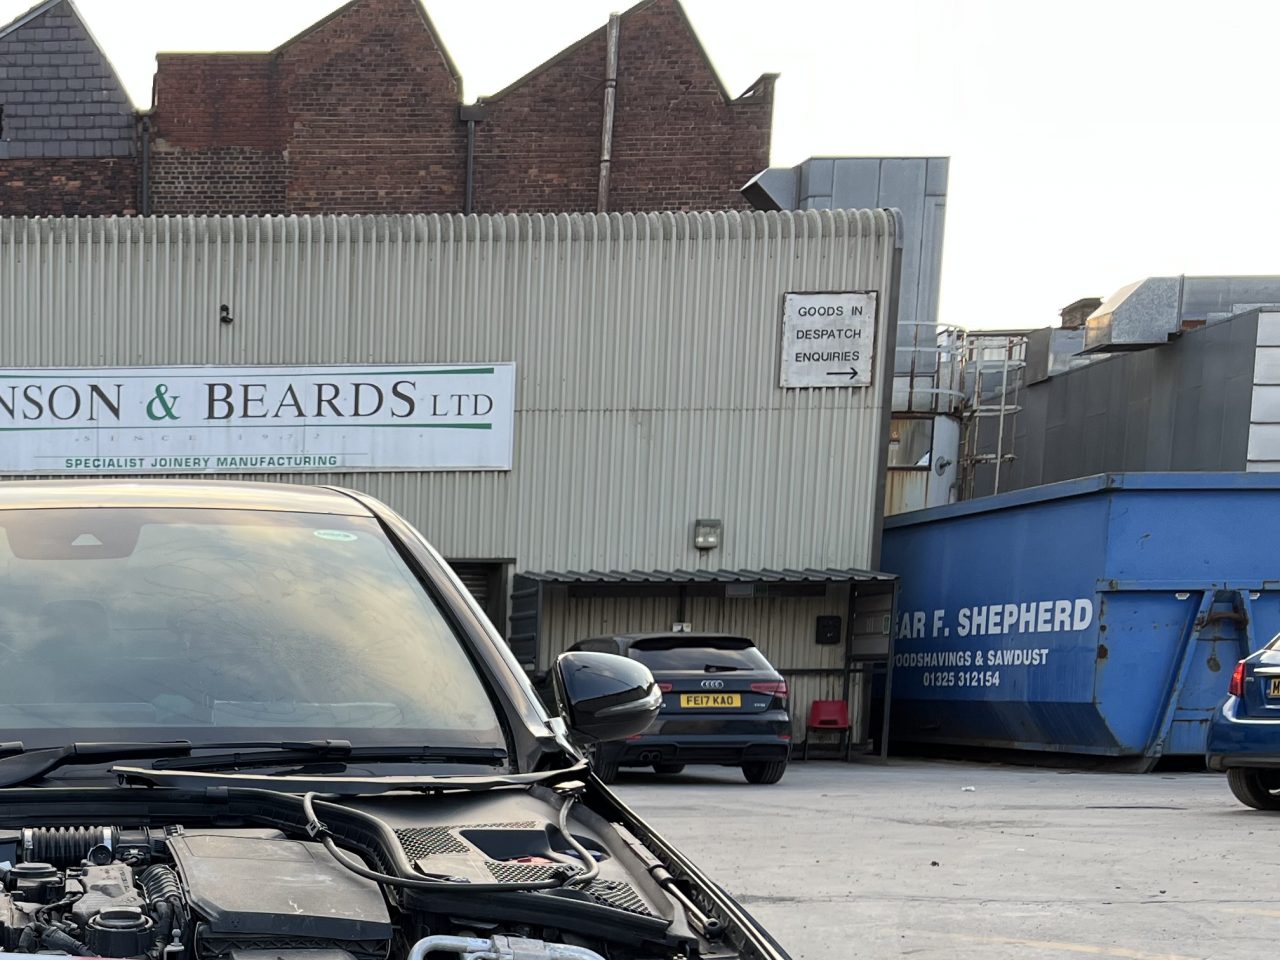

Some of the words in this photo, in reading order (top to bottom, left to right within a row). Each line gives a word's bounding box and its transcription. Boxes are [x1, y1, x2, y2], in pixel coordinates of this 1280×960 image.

[798, 306, 844, 316] GOODS
[851, 306, 863, 316] IN
[796, 328, 861, 339] DESPATCH
[795, 351, 860, 362] ENQUIRIES
[146, 383, 181, 421] &
[203, 380, 417, 420] BEARDS
[431, 393, 493, 416] LTD
[65, 457, 144, 468] SPECIALIST
[151, 457, 210, 468] JOINERY
[216, 456, 337, 467] MANUFACTURING
[932, 609, 950, 638] F.
[957, 598, 1093, 637] SHEPHERD
[893, 650, 972, 668] OODSHAVINGS
[975, 651, 984, 666] &
[987, 648, 1049, 666] SAWDUST
[923, 671, 955, 687] 01325
[957, 670, 1000, 686] 312154
[686, 695, 710, 705] FE17
